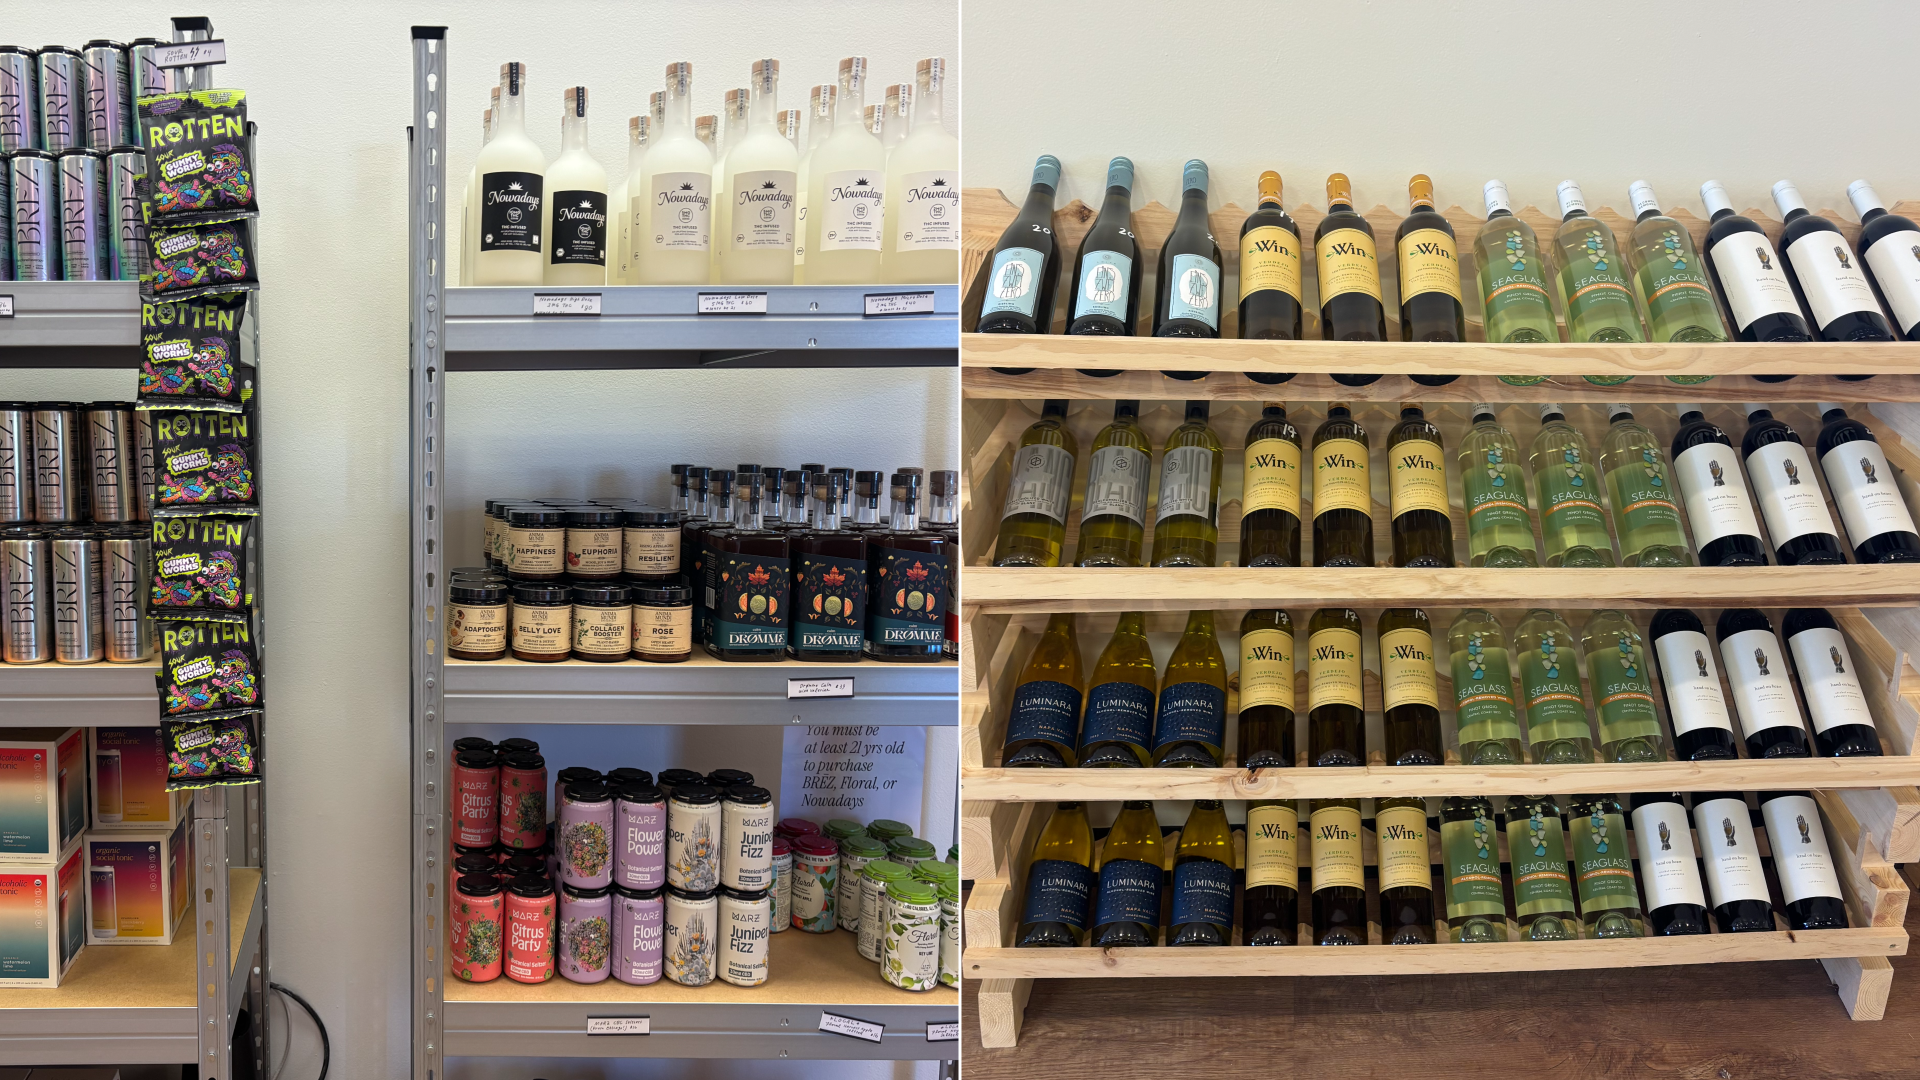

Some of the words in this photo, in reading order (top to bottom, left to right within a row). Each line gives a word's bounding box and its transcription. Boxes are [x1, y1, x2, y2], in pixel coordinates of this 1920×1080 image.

[164, 54, 188, 63] ROTTEN
[166, 48, 184, 56] SOUR
[151, 114, 243, 147] ROTTEN
[156, 150, 173, 164] SOUR
[166, 152, 199, 171] GUMMY
[167, 160, 203, 178] WORMS
[488, 190, 540, 211] Nowadays
[657, 190, 709, 211] Nowadays
[739, 189, 793, 209] Nowadays
[831, 186, 882, 206] Nowadays
[907, 186, 959, 206] Nowaday
[559, 207, 606, 228] Nowadays
[1032, 224, 1051, 235] 20
[1118, 227, 1135, 239] 20
[159, 233, 192, 249] GUMMY
[161, 239, 198, 256] WORMS
[1255, 239, 1289, 257] Win
[1332, 242, 1366, 258] Win
[1415, 242, 1450, 260] Win
[1491, 274, 1549, 291] SEAGLASS
[1574, 274, 1631, 291] SEAGLASS
[142, 303, 234, 331] ROTTEN
[144, 332, 163, 342] SOUR
[153, 342, 187, 354] GUMMY
[153, 348, 189, 360] WORMS
[159, 412, 247, 440] ROTTEN
[162, 445, 180, 457] SOUR
[173, 451, 205, 465] GUMMY
[173, 458, 208, 472] WORMS
[1255, 453, 1287, 468] Win
[1324, 453, 1355, 468] Win
[1402, 454, 1434, 470] Win
[1473, 490, 1526, 506] SEAGLASS
[153, 520, 242, 546] ROTTEN
[155, 548, 173, 558] SOUR
[163, 556, 196, 569] GUMMY
[163, 562, 199, 574] WORMS
[1275, 611, 1289, 625] 17
[1345, 609, 1358, 622] 17
[164, 622, 249, 651] ROTTEN
[519, 626, 540, 634] BELLY
[1252, 646, 1282, 662] Win
[1316, 644, 1345, 660] Win
[1395, 645, 1425, 662] Win
[168, 654, 186, 666] SOUR
[178, 659, 208, 674] GUMMY
[179, 666, 212, 681] WORMS
[1458, 684, 1507, 700] SEAGLASS
[1531, 682, 1580, 697] SEAGLASS
[1020, 697, 1072, 712] LUMINARA
[1096, 698, 1148, 714] LUMINARA
[1163, 698, 1214, 712] LUMINARA
[102, 730, 127, 738] organic
[170, 722, 188, 734] SOUR
[180, 728, 210, 742] GUMMY
[806, 726, 829, 736] You
[832, 726, 862, 736] must
[866, 726, 880, 736] be
[102, 737, 122, 745] social
[124, 737, 140, 745] tonic
[180, 734, 212, 748] WORMS
[804, 742, 818, 754] at
[820, 740, 848, 754] least
[849, 740, 862, 754] 21
[862, 744, 883, 757] yrs
[885, 741, 905, 754] old
[804, 760, 816, 772] to
[816, 759, 874, 774] purchase
[840, 776, 879, 791] Floral,
[883, 780, 898, 790] or
[462, 792, 492, 806] Citrus
[801, 794, 864, 810] Nowadays
[462, 806, 489, 818] Party
[628, 827, 664, 841] Flower
[741, 831, 773, 845] Junipe
[1261, 824, 1290, 840] Win
[1321, 825, 1350, 840] Win
[1387, 825, 1415, 840] Win
[96, 847, 120, 856] organic
[628, 842, 662, 856] Power
[740, 845, 763, 858] Fizz
[1520, 861, 1566, 874] SEAGLASS
[1582, 858, 1629, 872] SEAGLASS
[1041, 878, 1088, 894] LUMINARA
[1107, 878, 1155, 890] LUMINARA
[1184, 878, 1231, 892] LUMINARA
[512, 922, 544, 939] Citrus
[730, 925, 768, 940] Juniper
[907, 927, 938, 943] Floral
[512, 936, 540, 952] Party
[730, 939, 753, 953] Fizz
[511, 958, 530, 967] Botanical
